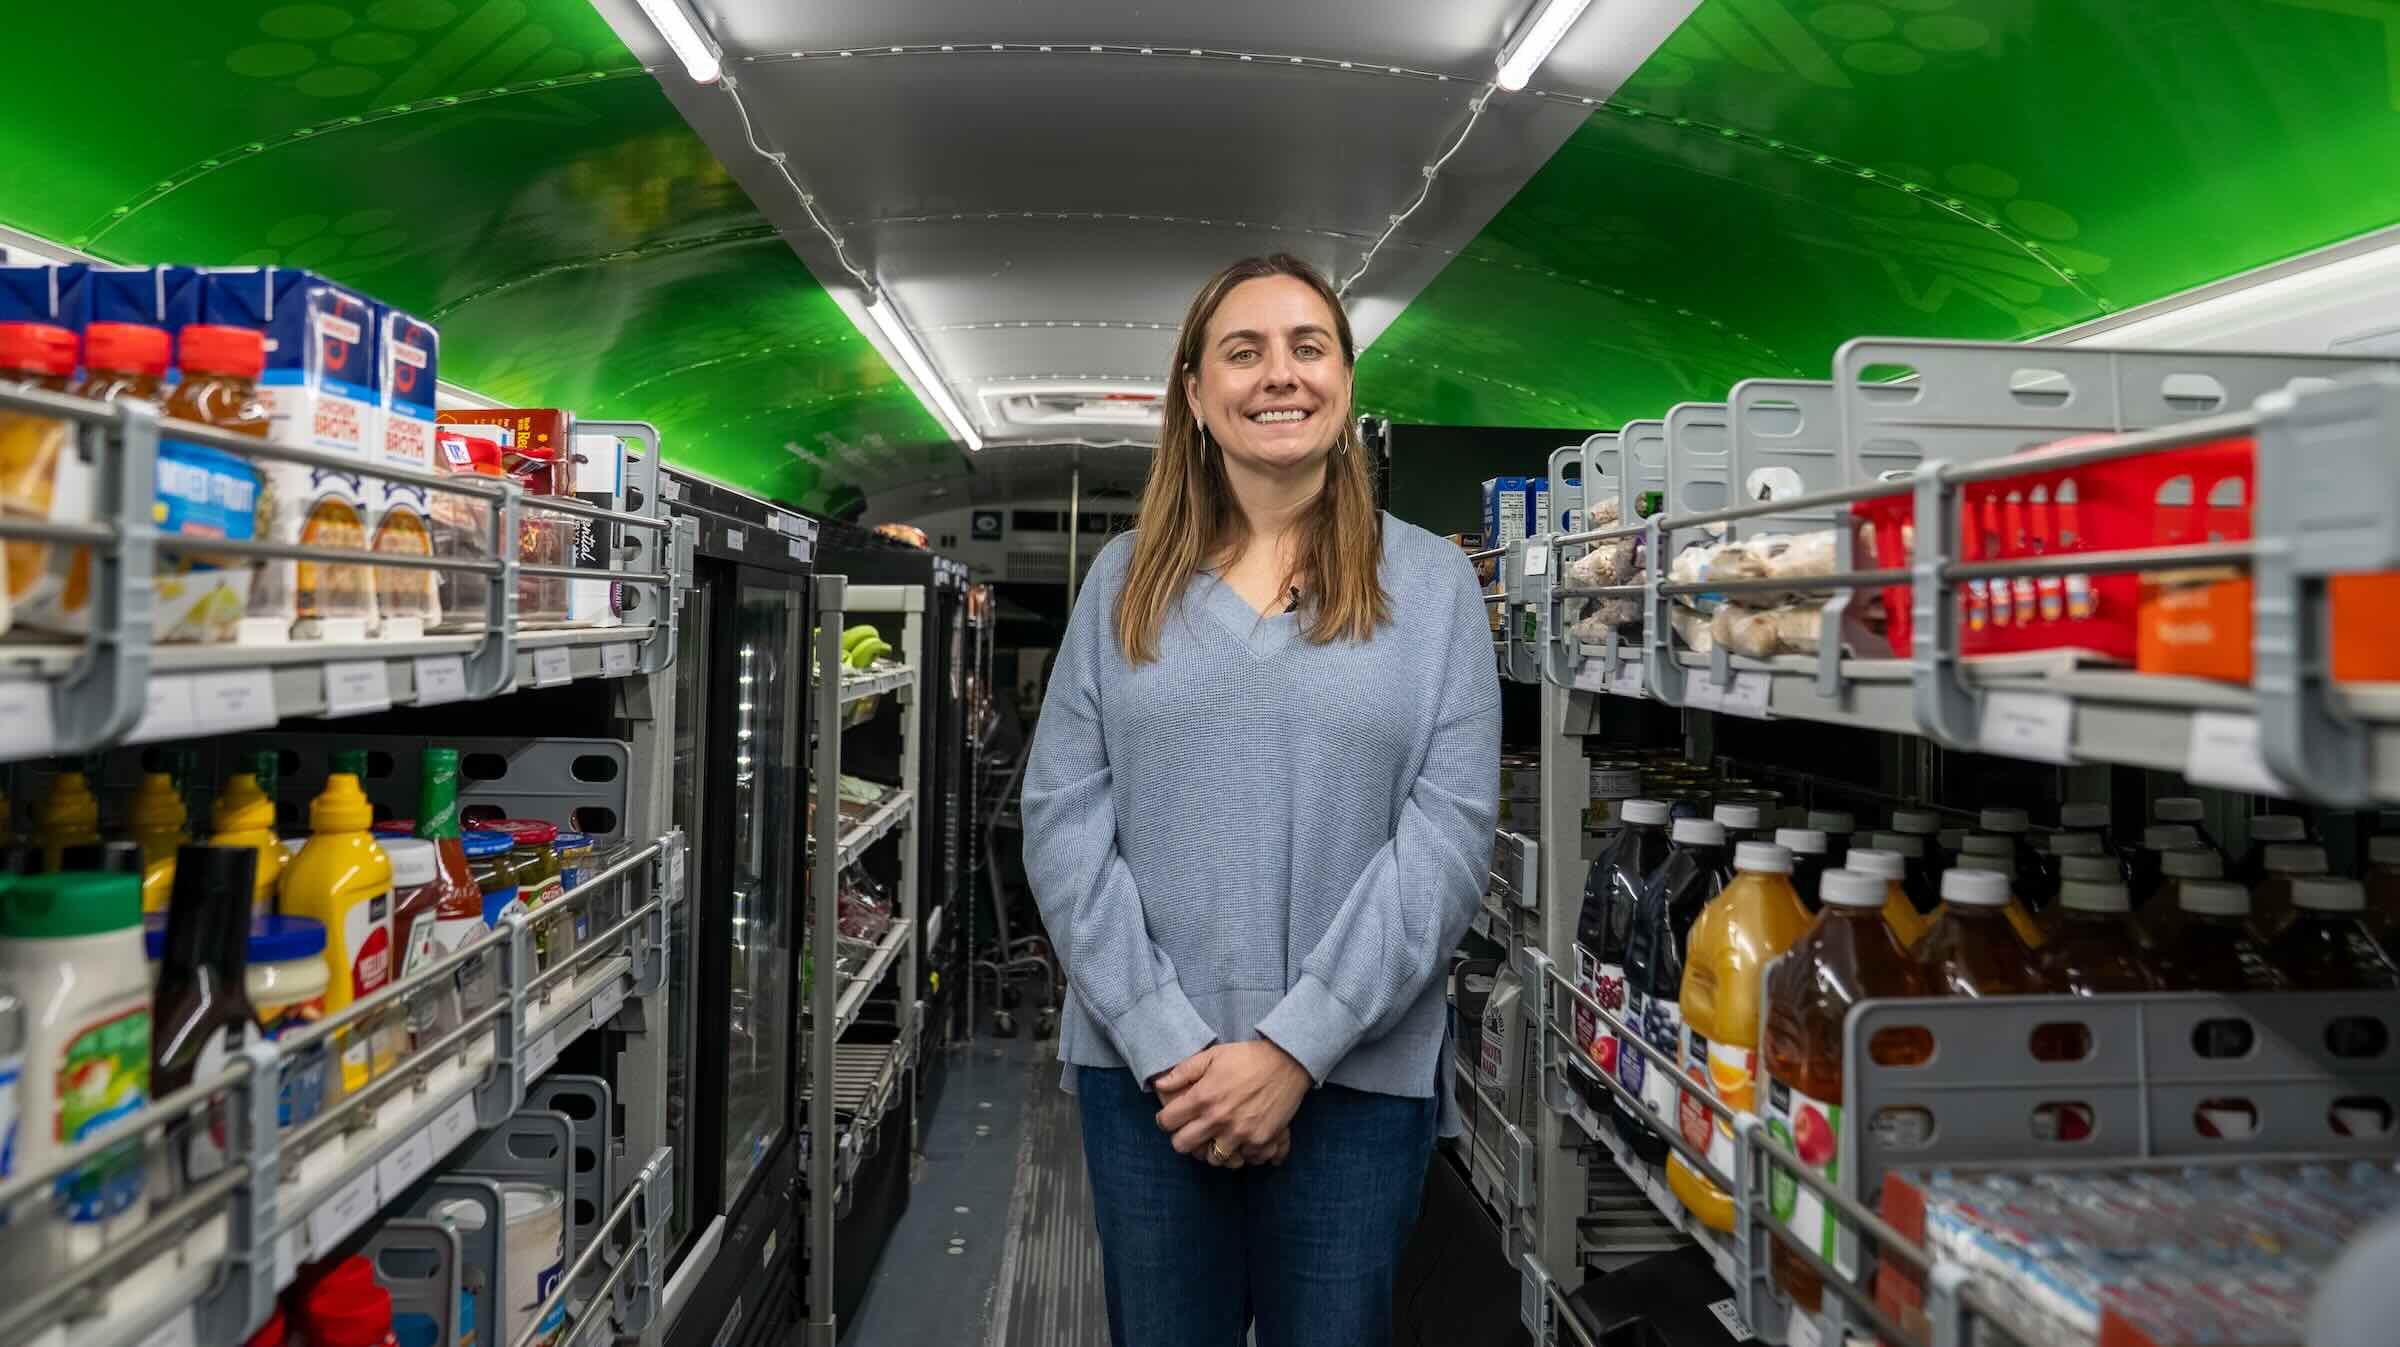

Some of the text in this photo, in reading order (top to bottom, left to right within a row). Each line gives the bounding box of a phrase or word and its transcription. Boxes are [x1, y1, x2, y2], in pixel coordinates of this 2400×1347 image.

[315, 414, 359, 442] BROTH
[517, 431, 531, 449] Rea
[384, 431, 425, 459] BROTH
[580, 518, 597, 561] ential
